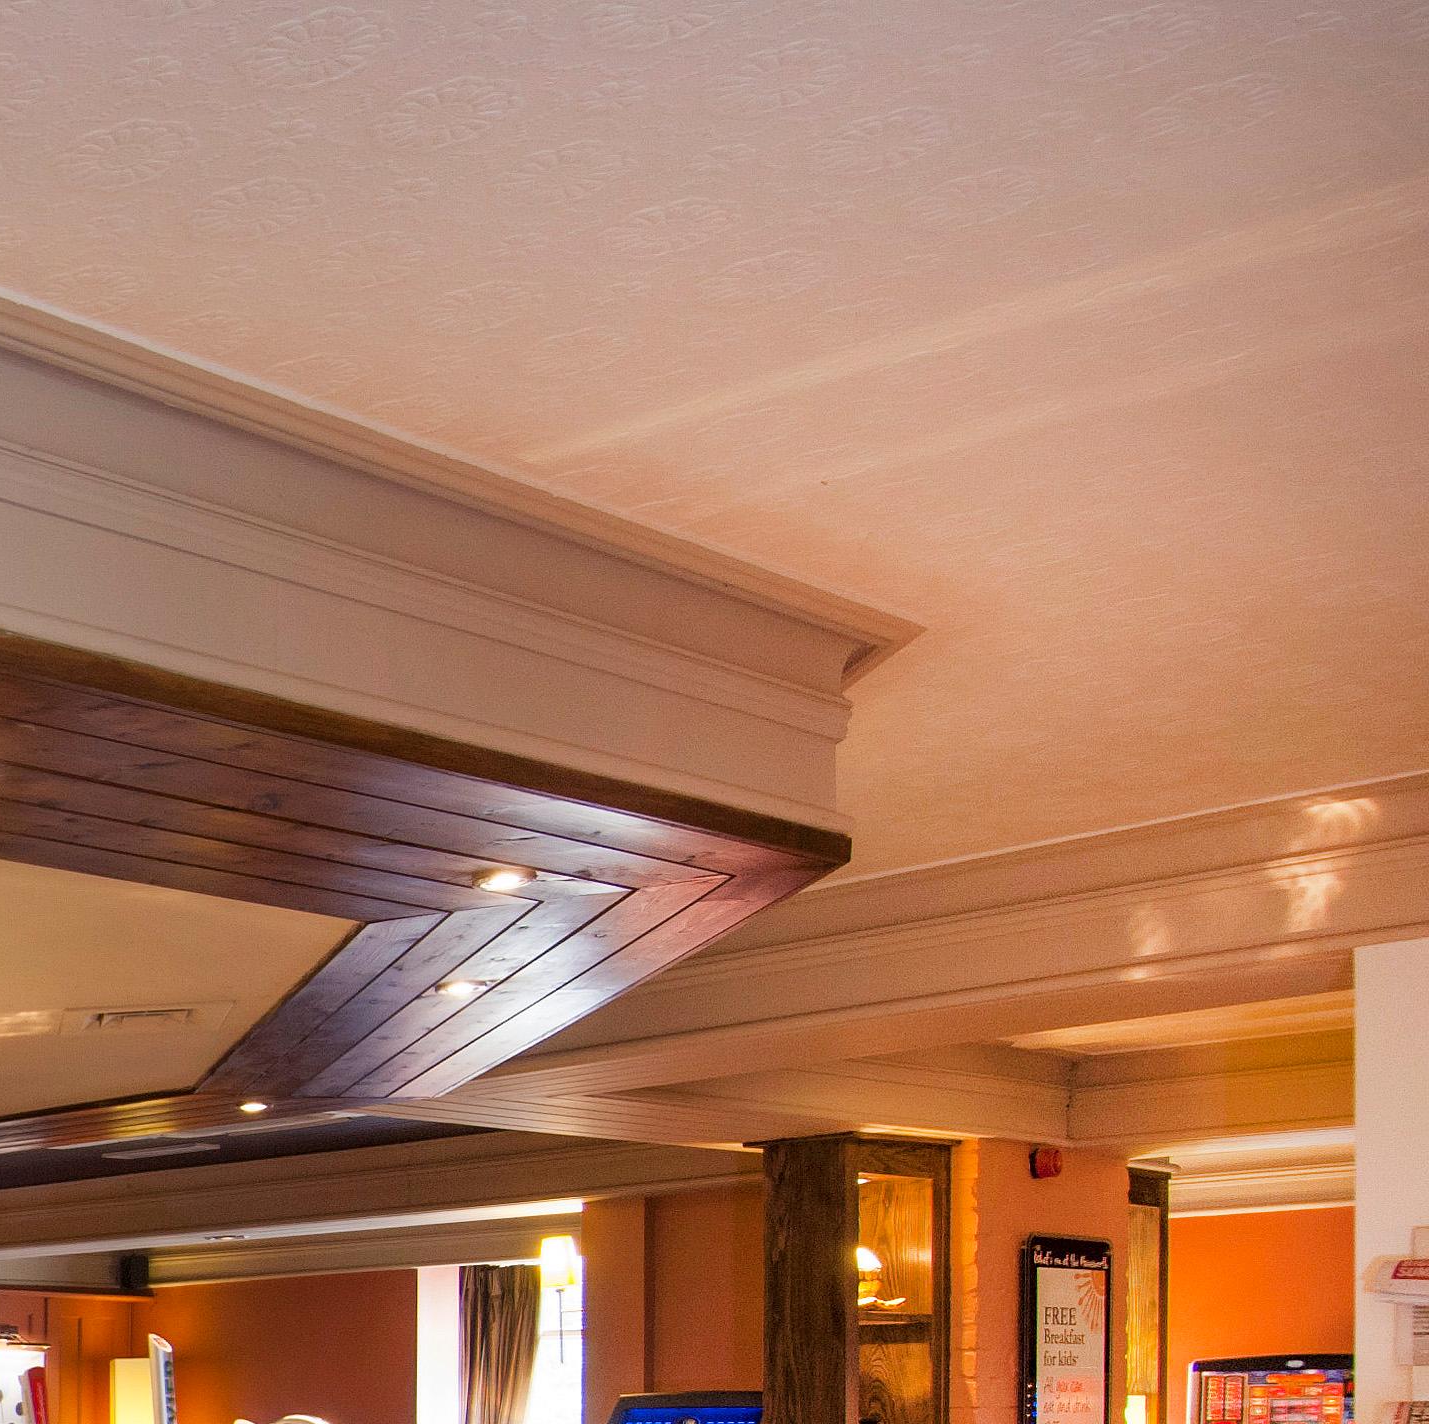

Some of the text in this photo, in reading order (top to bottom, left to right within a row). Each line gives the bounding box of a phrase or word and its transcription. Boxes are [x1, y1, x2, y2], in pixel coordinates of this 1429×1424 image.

[1044, 1306, 1077, 1325] FREE
[1044, 1328, 1085, 1345] Breakfast
[1044, 1350, 1056, 1367] for
